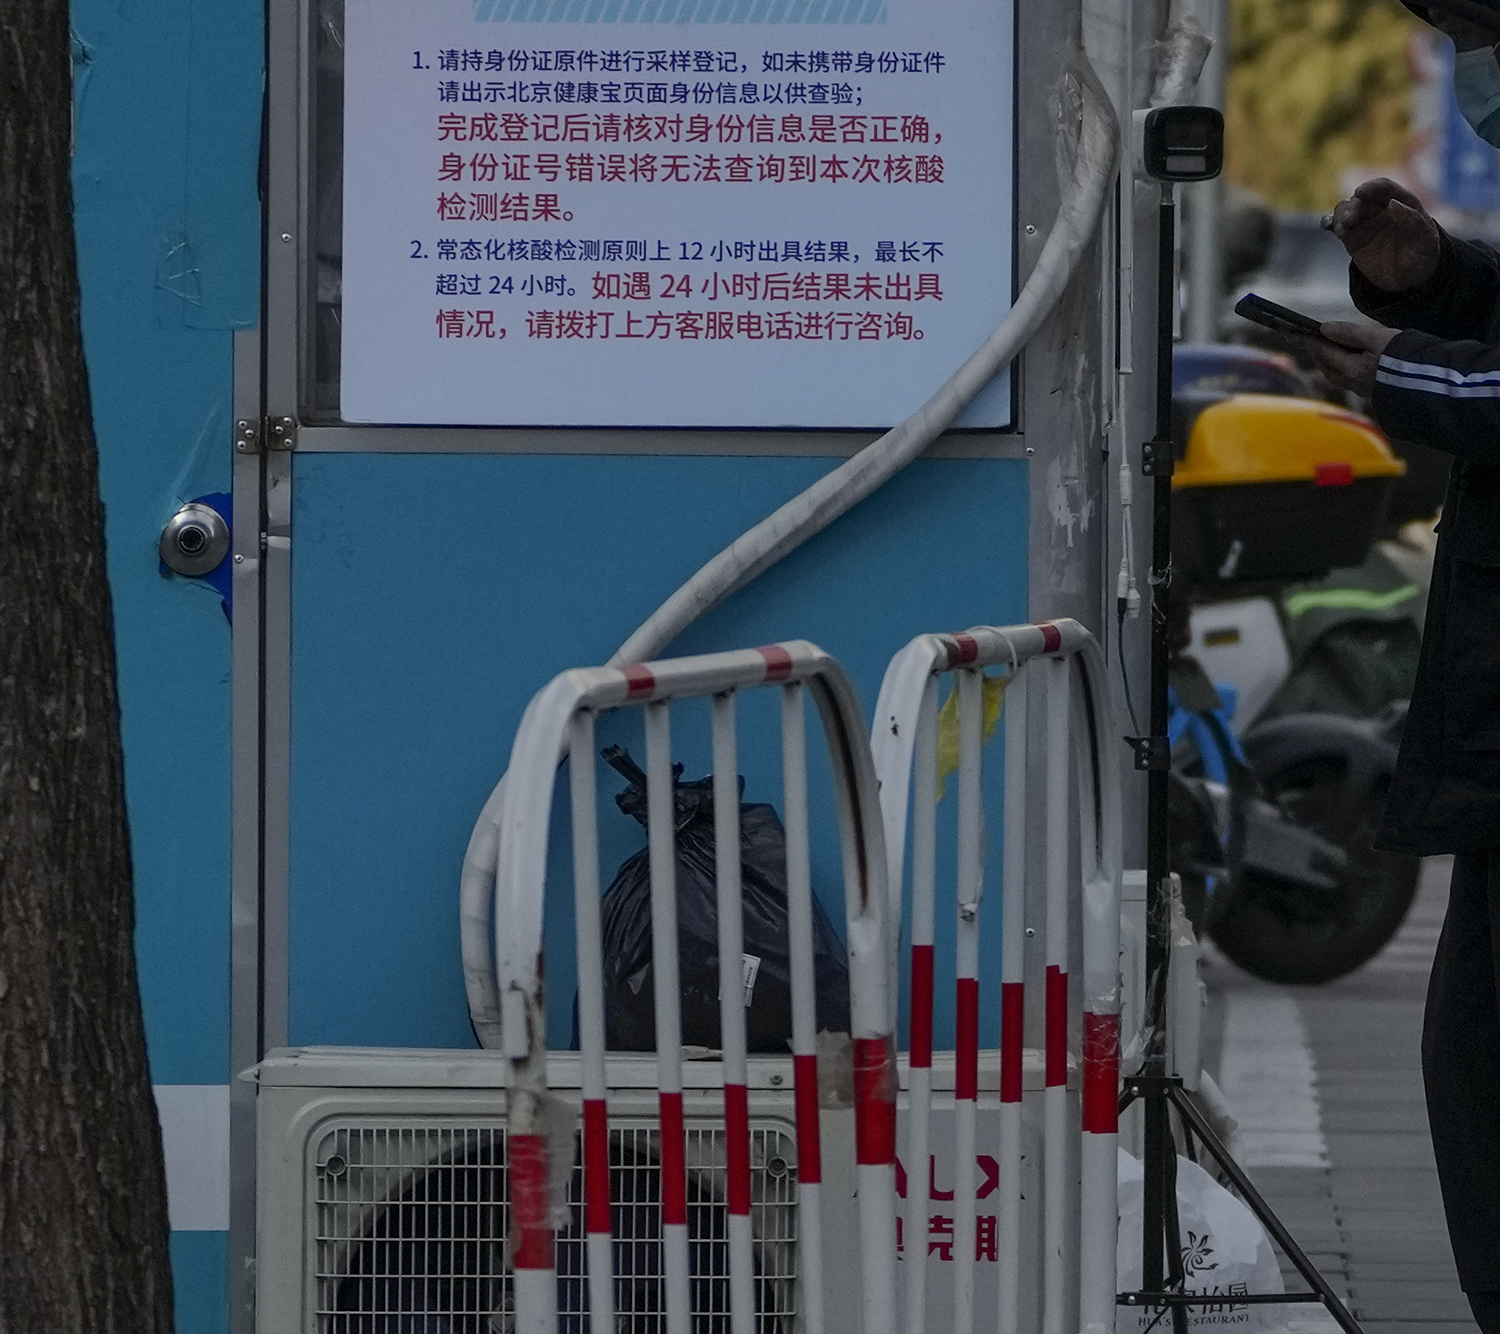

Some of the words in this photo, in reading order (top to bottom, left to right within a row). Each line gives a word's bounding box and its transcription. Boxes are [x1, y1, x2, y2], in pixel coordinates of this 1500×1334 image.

[437, 112, 943, 145] 完成登记后请核对身份信息是否正确，
[437, 152, 945, 184] 身份证号错误将无法查询到本次核酸
[436, 192, 575, 222] 检测结果。
[435, 308, 926, 341] 情况，请拨打上方客服电话进行咨询。
